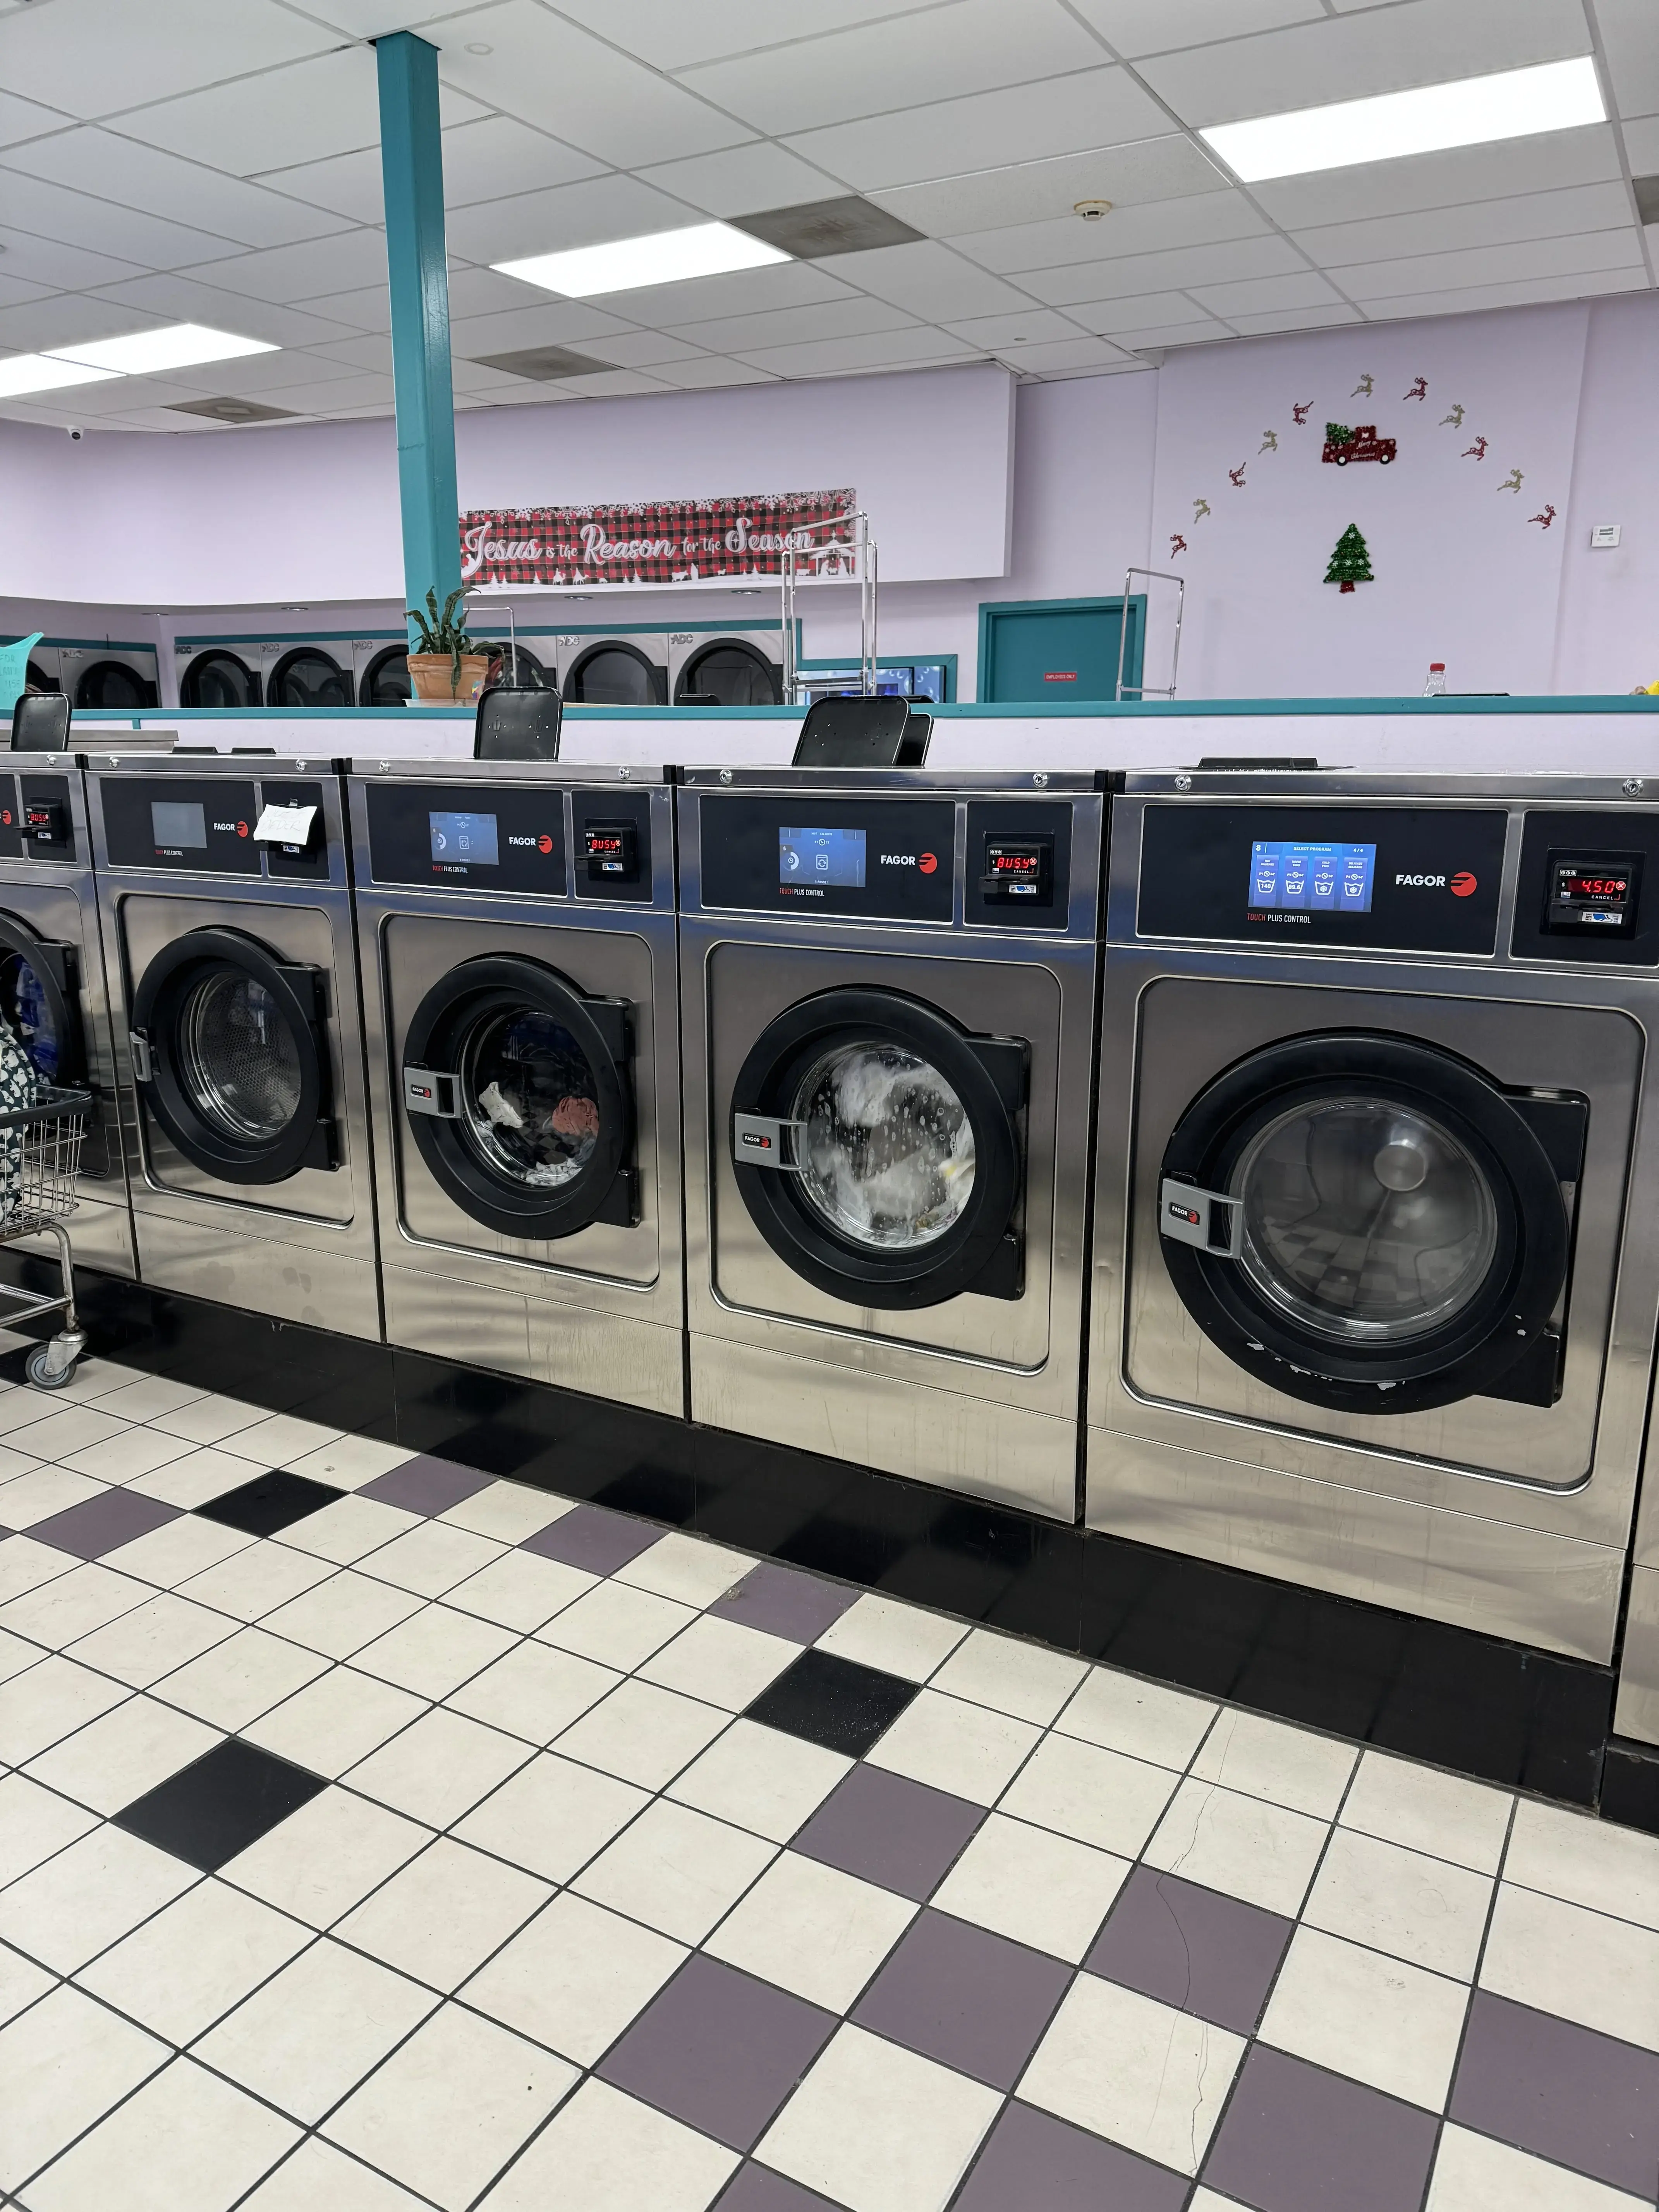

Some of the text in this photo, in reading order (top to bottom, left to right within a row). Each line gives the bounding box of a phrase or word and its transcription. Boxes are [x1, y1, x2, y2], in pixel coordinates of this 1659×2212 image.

[461, 517, 815, 578] Jesus is the Reason for the Season
[559, 636, 580, 646] ADC
[670, 634, 693, 644] ADC
[354, 641, 373, 650] ADC
[214, 823, 235, 831] FAGOR
[509, 837, 536, 846] FAGOR
[881, 855, 915, 866] FAGOR
[1395, 874, 1445, 888] FAGOR
[1582, 880, 1615, 893] 4.50
[1247, 913, 1311, 924] TOUCH PLUS CONTROL
[1172, 1206, 1188, 1216] FAGOR
